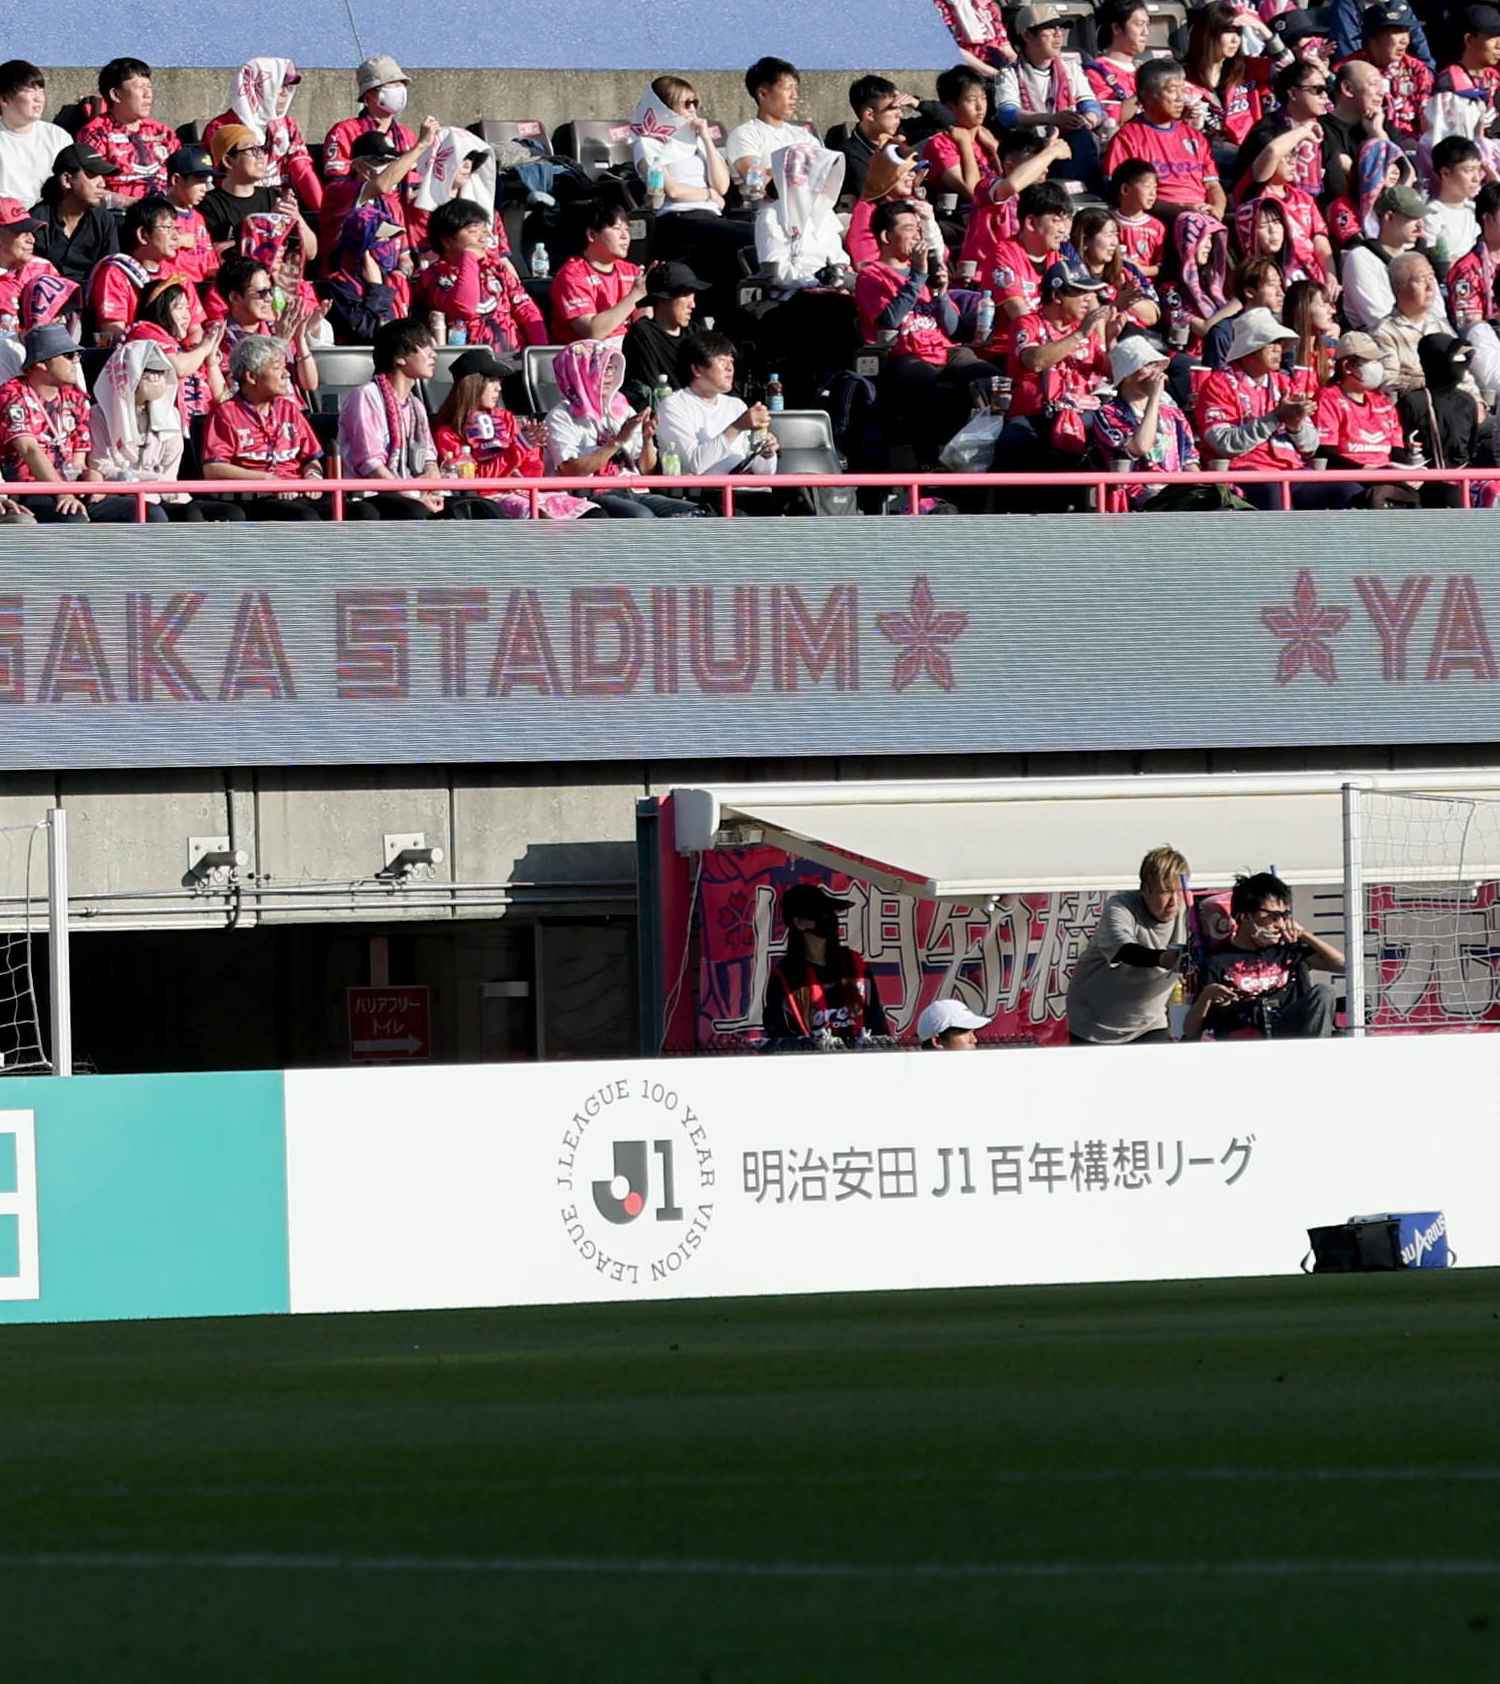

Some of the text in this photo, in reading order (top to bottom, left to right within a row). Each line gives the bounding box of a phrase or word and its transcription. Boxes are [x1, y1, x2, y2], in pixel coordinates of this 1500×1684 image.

[336, 582, 859, 700] STADIUM
[355, 997, 421, 1013] バリアフリー
[373, 1019, 404, 1034] トイレ
[591, 1139, 684, 1226] J1
[680, 1104, 716, 1188] YEAR
[743, 1132, 1258, 1204] 明治安田 J1 百年構想リーグ
[560, 1203, 640, 1285] LEAGUE
[650, 1202, 715, 1283] VISION
